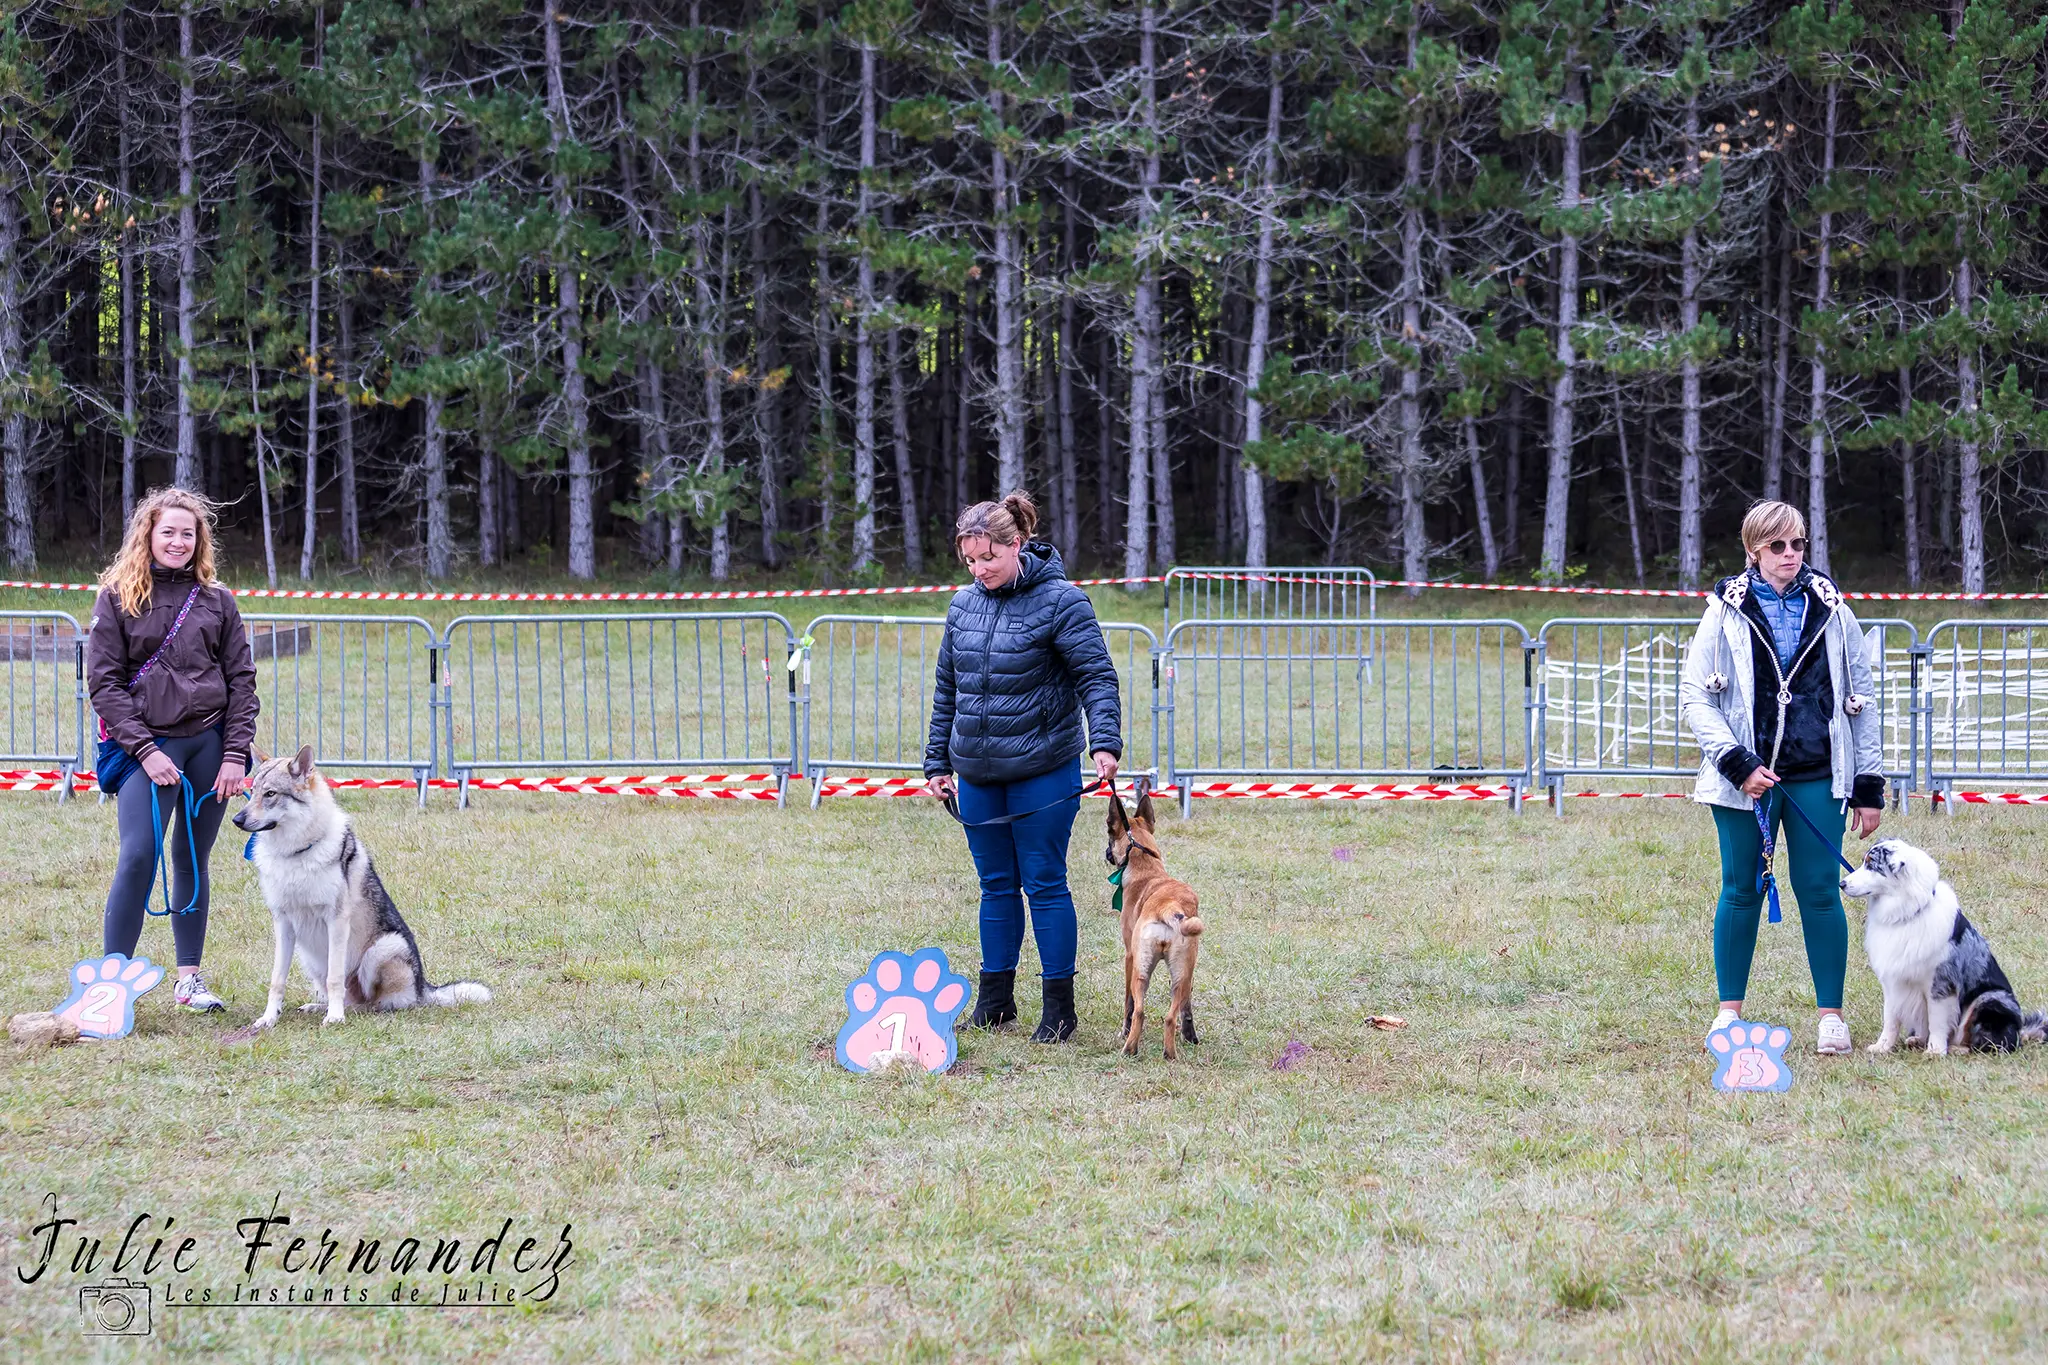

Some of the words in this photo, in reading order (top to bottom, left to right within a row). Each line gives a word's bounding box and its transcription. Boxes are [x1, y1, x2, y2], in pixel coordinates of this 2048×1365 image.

[79, 985, 118, 1024] 2
[878, 1012, 911, 1054] 1
[1738, 1053, 1764, 1085] 3
